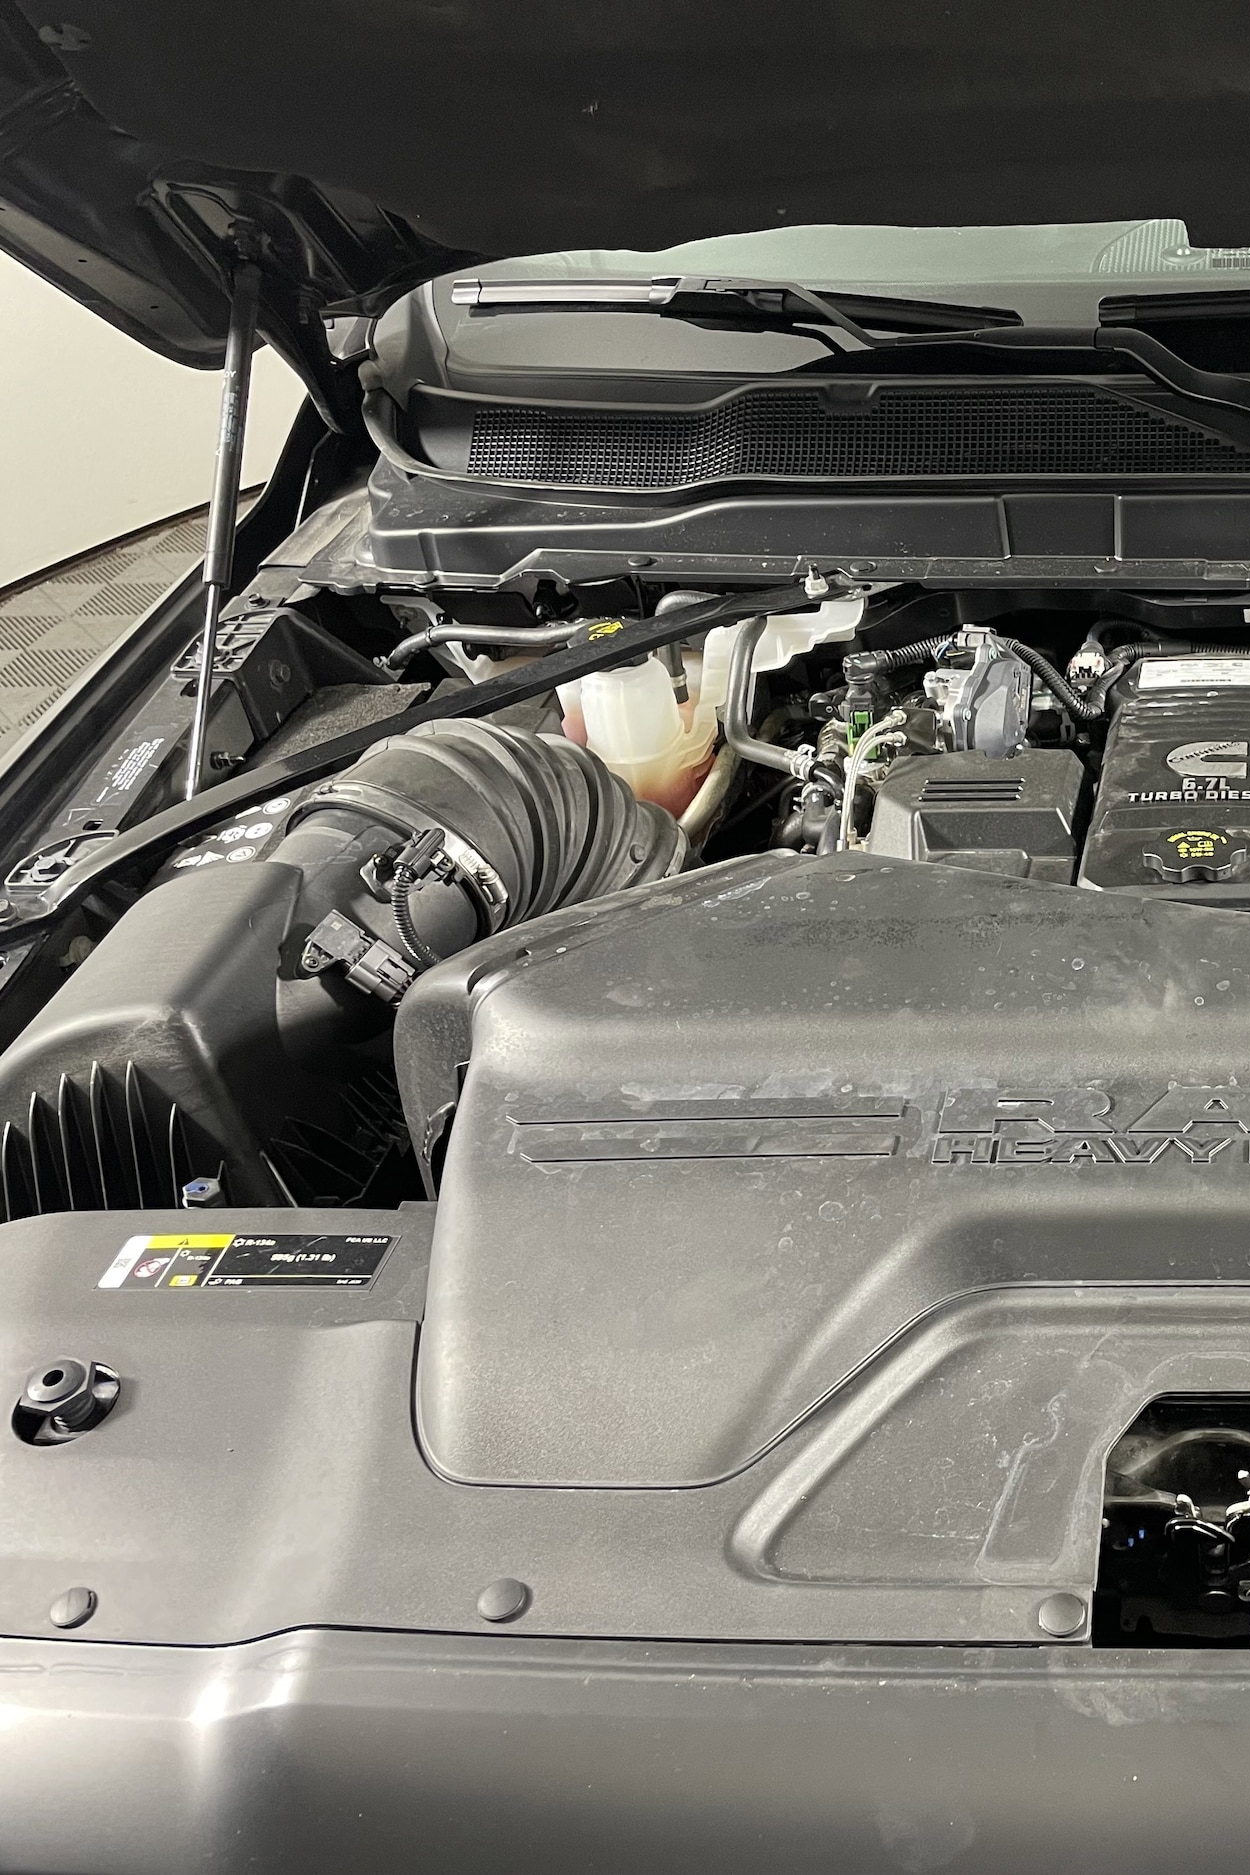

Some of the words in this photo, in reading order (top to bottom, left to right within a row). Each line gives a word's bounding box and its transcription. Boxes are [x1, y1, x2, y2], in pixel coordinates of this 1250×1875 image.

[1182, 777, 1231, 791] 6.7L
[1128, 790, 1198, 802] TURBO
[931, 1137, 1235, 1164] HEAVY
